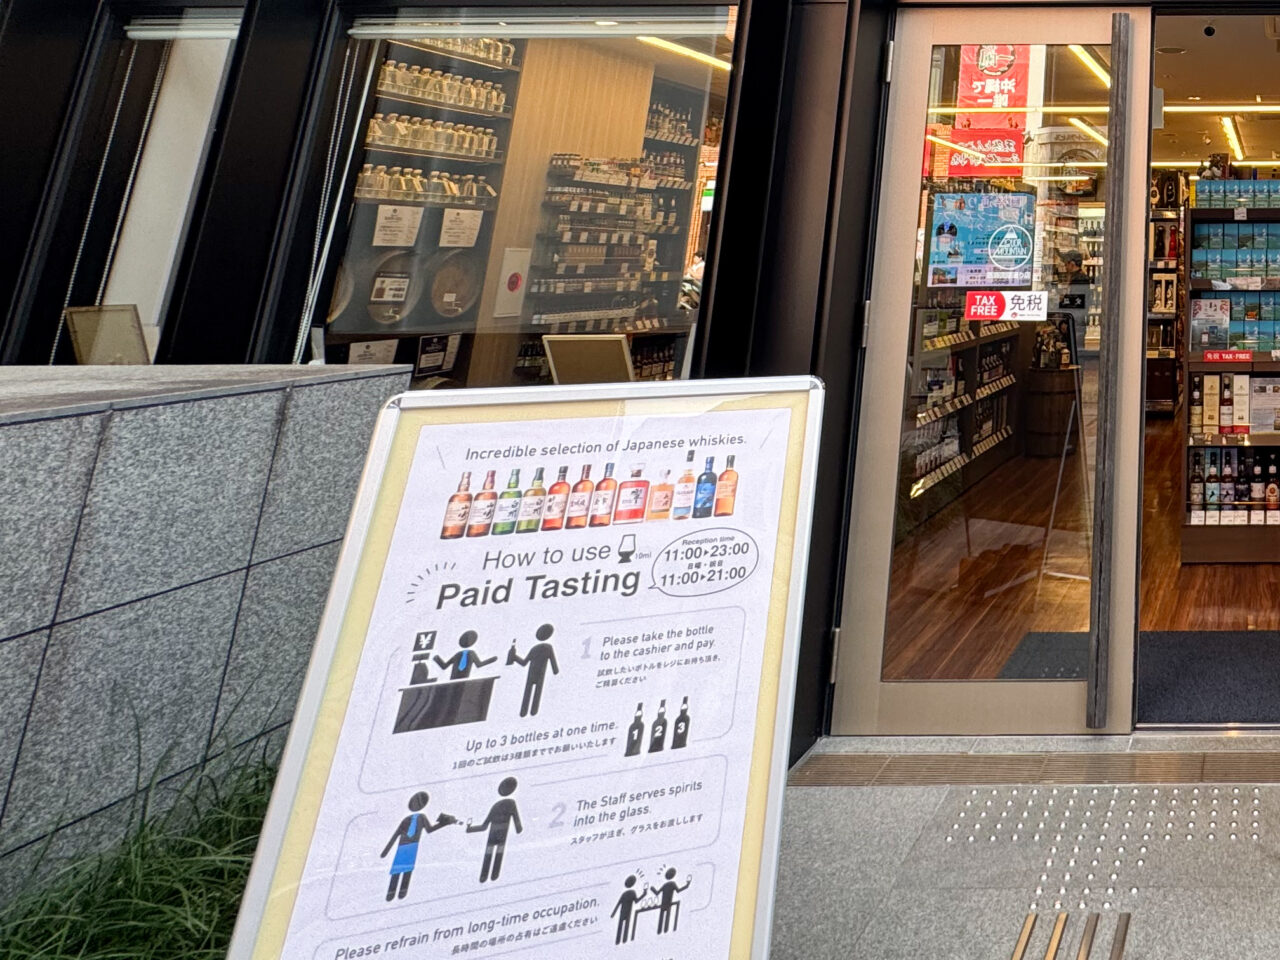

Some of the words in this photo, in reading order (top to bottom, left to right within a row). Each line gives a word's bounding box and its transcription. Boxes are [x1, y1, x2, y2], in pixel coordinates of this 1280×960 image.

[974, 295, 996, 306] TAX
[1009, 294, 1043, 311] 免税
[971, 306, 998, 316] FREE
[1222, 352, 1250, 360] TAX-FREE
[466, 444, 537, 461] Incredible
[540, 441, 602, 456] selection
[605, 439, 621, 452] of
[622, 438, 685, 453] Japanese
[688, 434, 748, 448] whiskies.
[482, 549, 535, 571] How
[542, 548, 564, 566] to
[571, 545, 611, 562] use
[435, 576, 513, 610] Paid
[525, 568, 641, 601] Tasting
[603, 634, 638, 647] Please
[642, 631, 664, 642] take
[667, 628, 683, 639] the
[686, 624, 714, 637] bottle
[600, 650, 610, 661] to
[613, 648, 630, 658] the
[632, 643, 672, 657] cashier
[674, 640, 694, 651] and
[632, 729, 640, 740] 1
[654, 725, 664, 737] 2
[677, 722, 685, 733] 3
[466, 740, 482, 754] Up
[485, 738, 497, 749] to
[499, 735, 508, 746] 3
[510, 730, 549, 745] bottles
[552, 727, 564, 739] at
[567, 726, 587, 737] one
[590, 721, 619, 733] time.
[577, 800, 597, 811] The
[601, 794, 627, 808] Staff
[629, 789, 666, 803] serves
[668, 781, 703, 797] spirits
[573, 814, 596, 828] into
[598, 811, 617, 823] the
[335, 942, 381, 960] Please
[384, 931, 430, 953] refrain
[432, 925, 464, 944] from
[467, 911, 529, 938] long-time
[532, 898, 601, 925] occupation.
